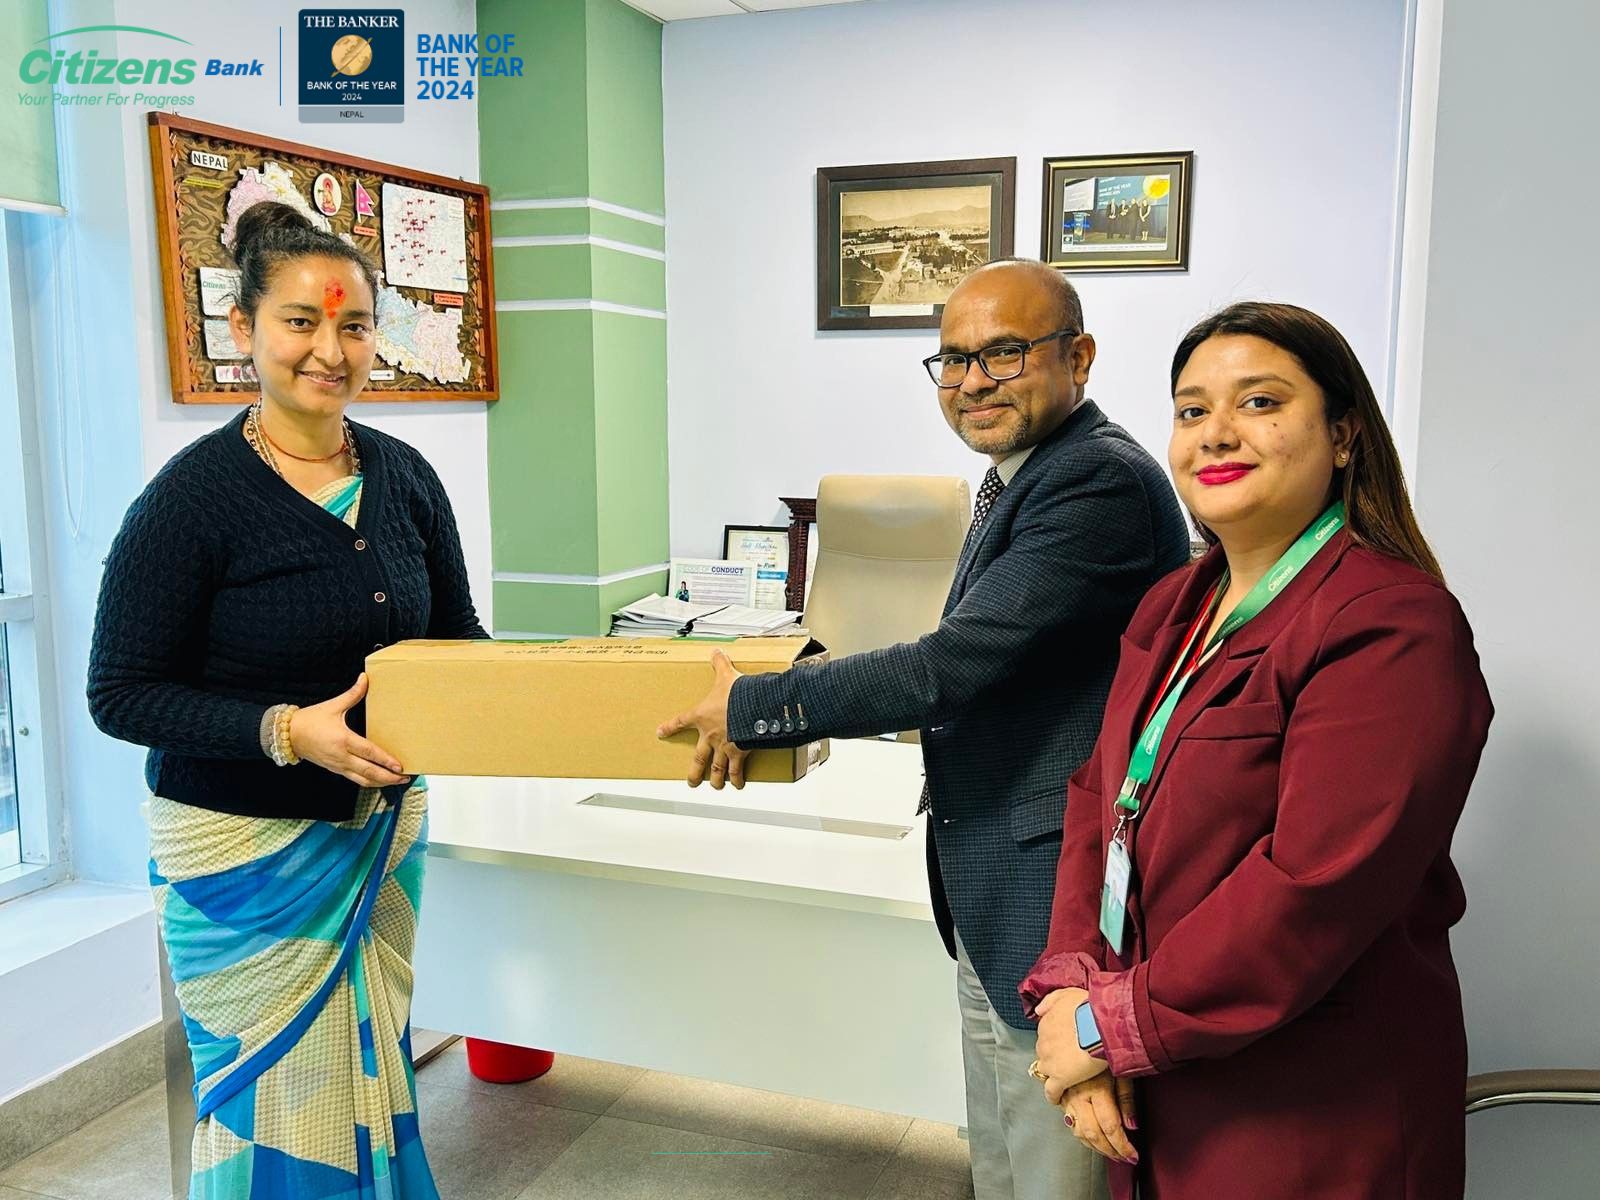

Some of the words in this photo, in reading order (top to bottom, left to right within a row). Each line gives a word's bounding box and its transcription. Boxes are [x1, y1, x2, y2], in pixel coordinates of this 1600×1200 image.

[193, 153, 228, 168] NEPAL
[1315, 516, 1340, 541] Citizens
[711, 566, 744, 574] CONDUCT
[1268, 565, 1294, 592] Citizens
